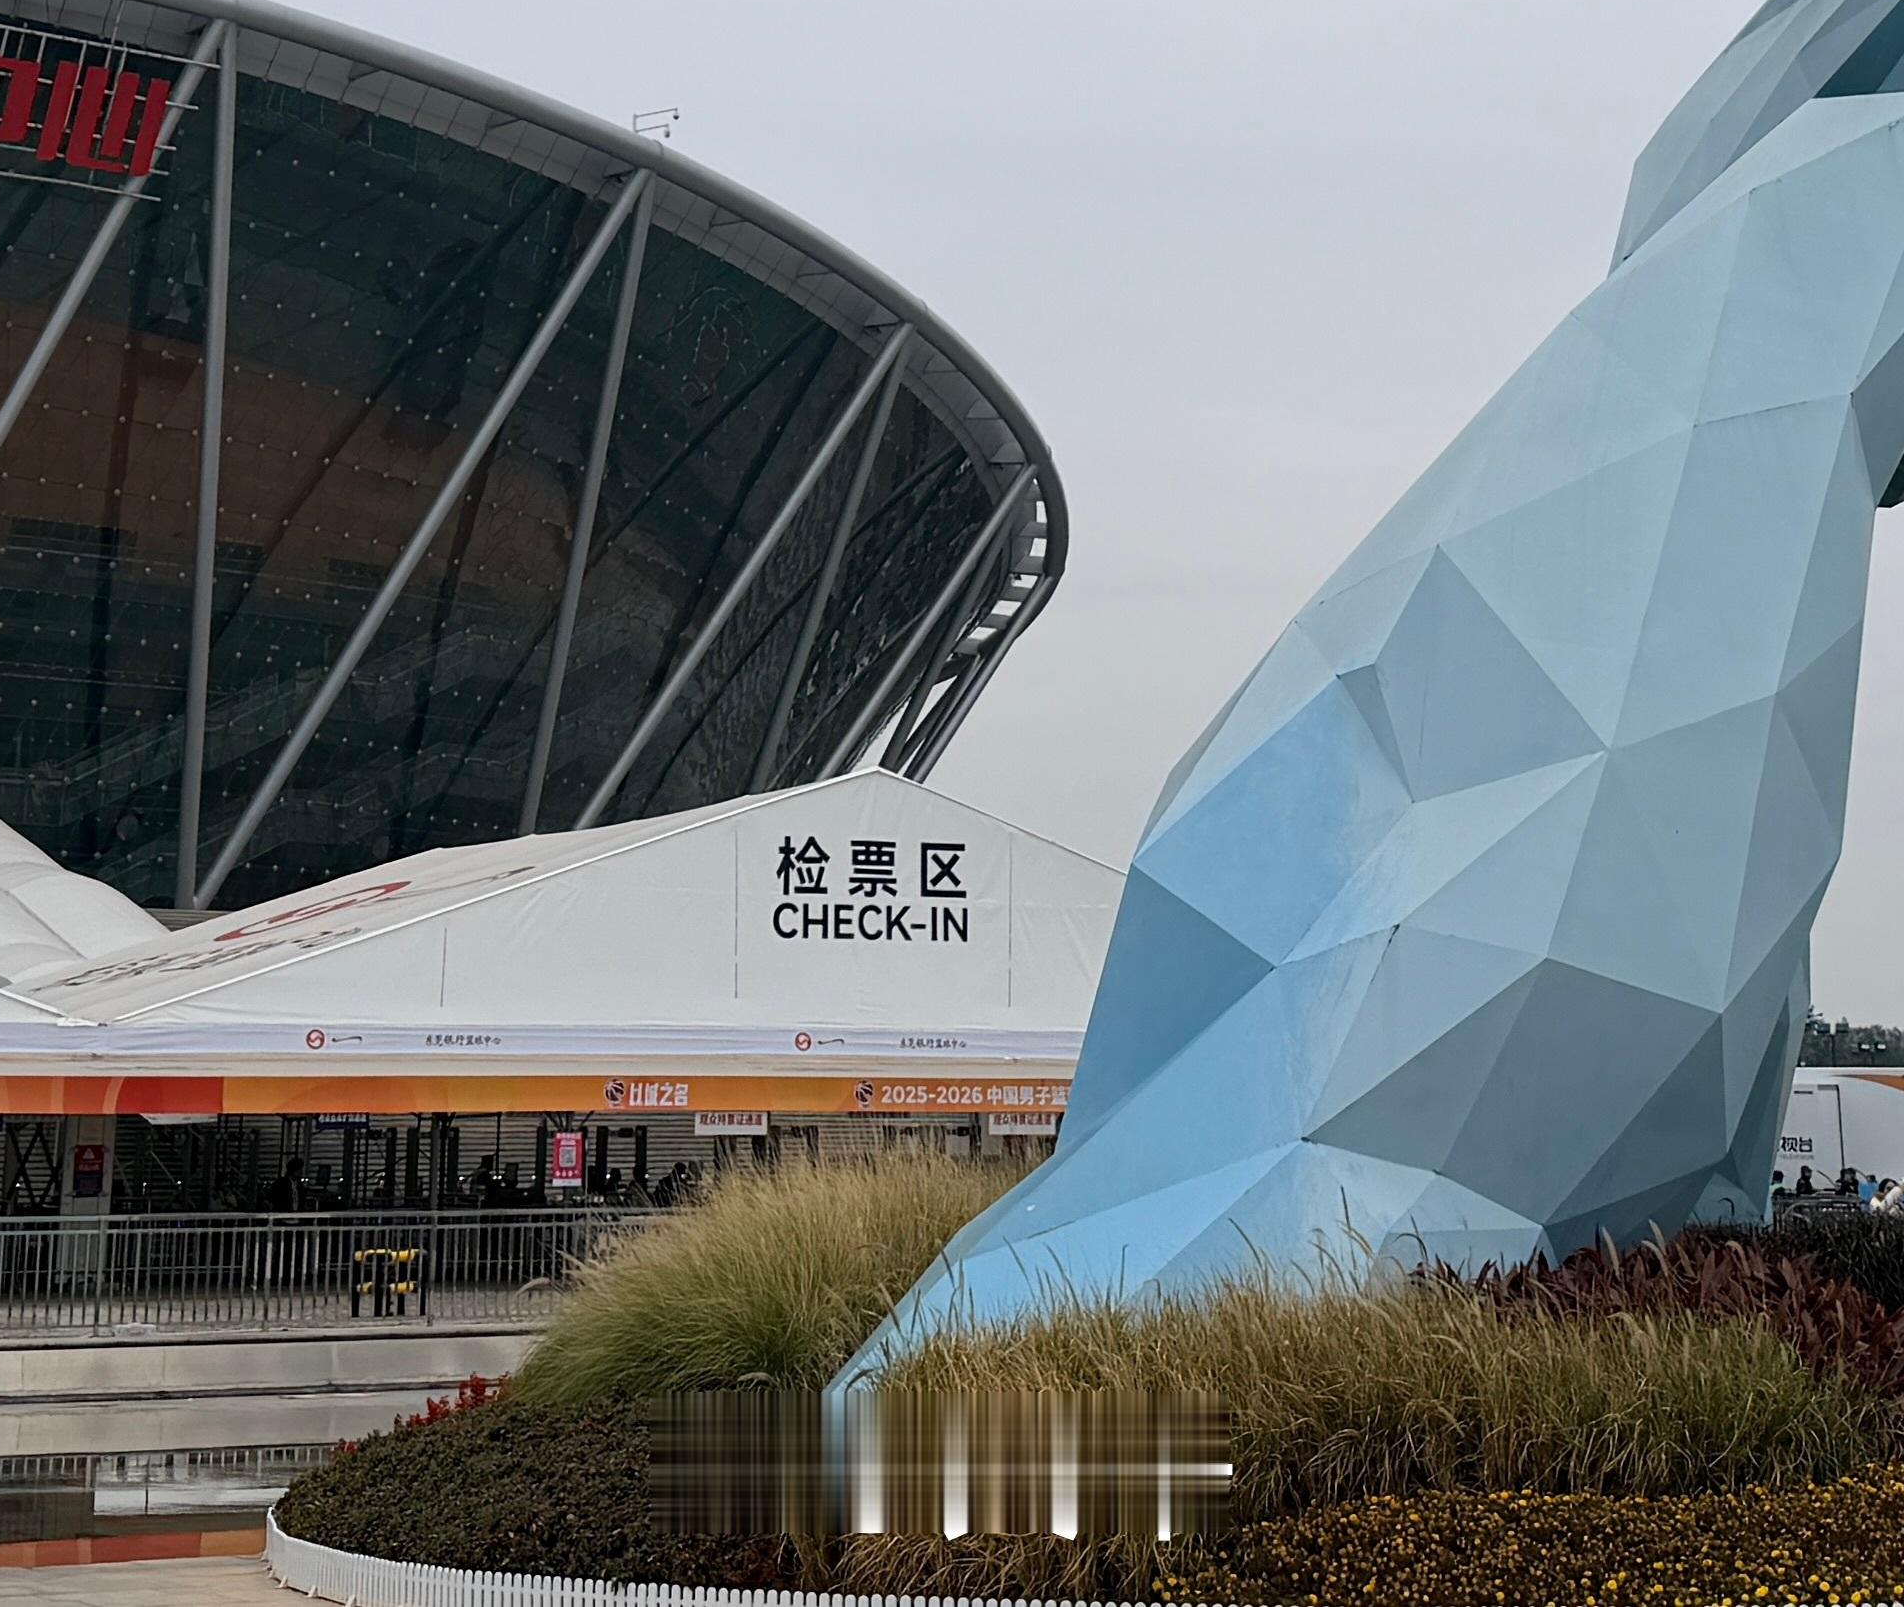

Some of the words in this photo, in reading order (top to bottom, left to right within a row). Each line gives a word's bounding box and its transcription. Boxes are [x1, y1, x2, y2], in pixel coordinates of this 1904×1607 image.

[776, 835, 967, 898] 检票区
[773, 902, 969, 942] CHECK-IN
[629, 1081, 689, 1107] 以城之名
[880, 1085, 983, 1105] 2025-2026
[987, 1085, 1071, 1106] 中国男子篮
[1777, 1136, 1813, 1153] 视台
